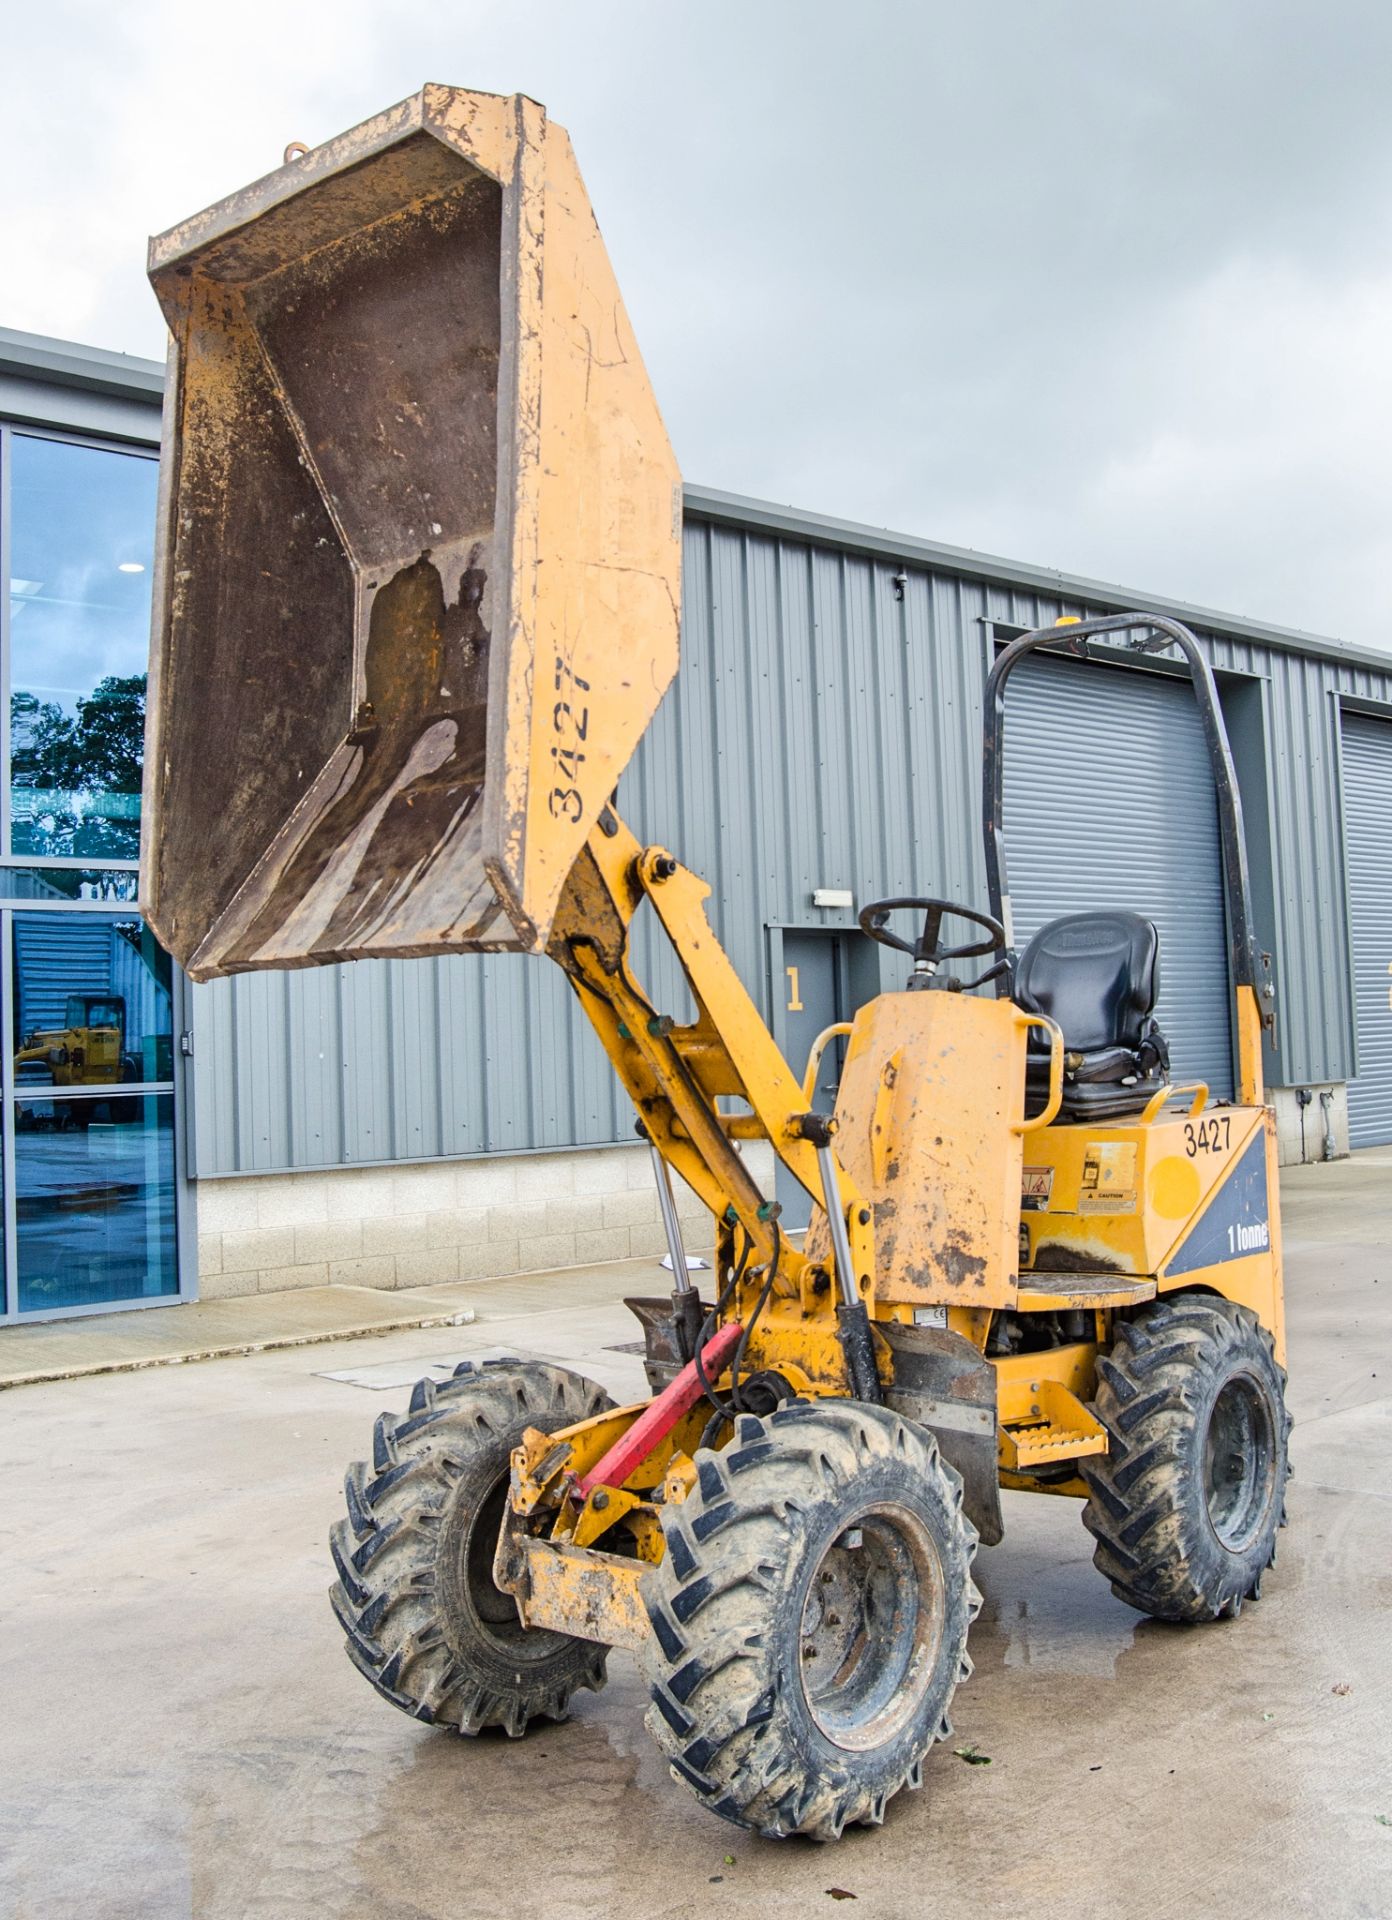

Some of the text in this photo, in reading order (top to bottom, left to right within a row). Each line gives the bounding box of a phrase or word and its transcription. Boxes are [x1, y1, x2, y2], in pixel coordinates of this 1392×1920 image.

[549, 656, 590, 824] 3427
[786, 966, 804, 1012] 1
[1184, 1117, 1231, 1158] 3427
[1227, 1222, 1268, 1254] 1 tonne
